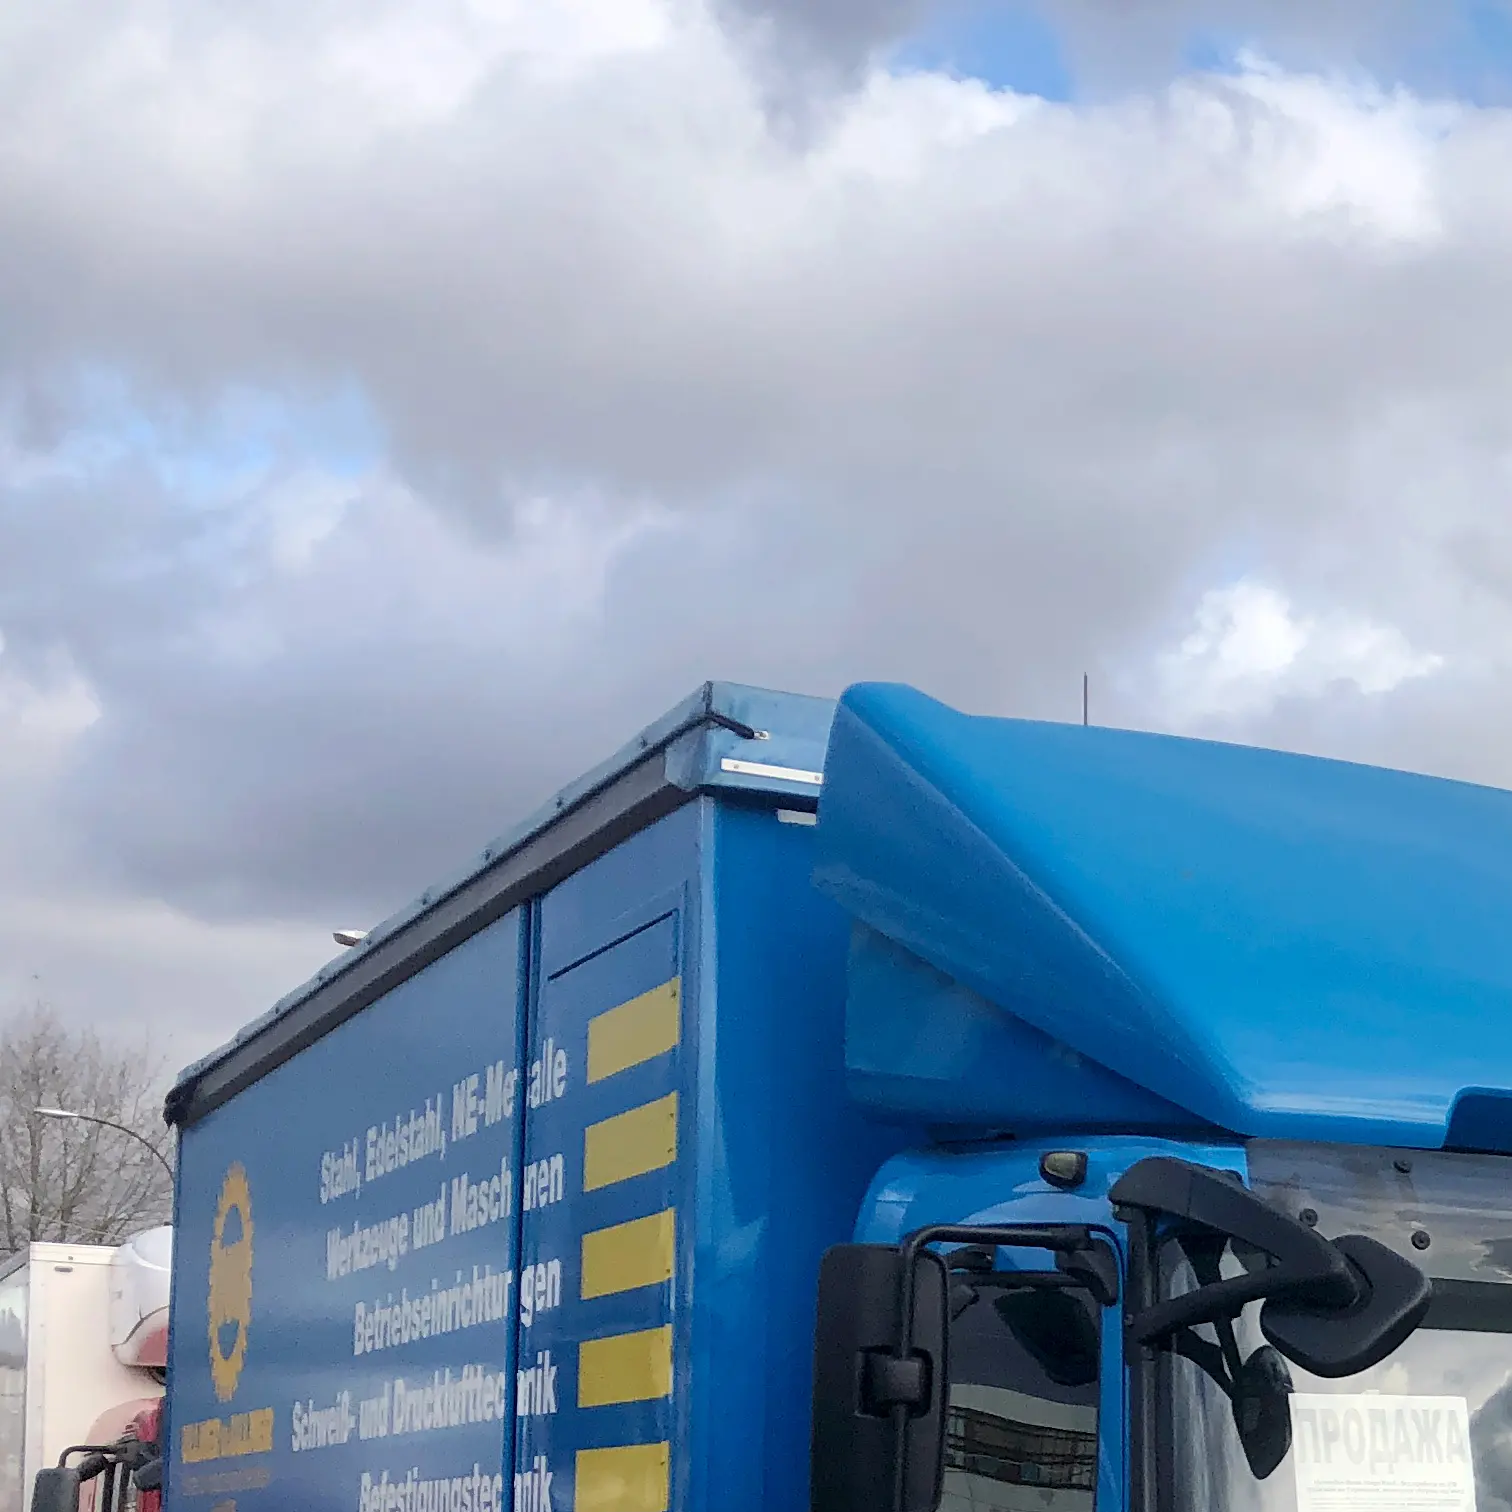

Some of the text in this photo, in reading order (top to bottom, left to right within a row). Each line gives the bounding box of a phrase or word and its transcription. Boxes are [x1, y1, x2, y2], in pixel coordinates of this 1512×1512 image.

[320, 1037, 568, 1204] Stahl, Edelstahl, NE-Mealle
[326, 1153, 564, 1281] Werkzeuge und Maschnen
[359, 1381, 391, 1441] und
[1295, 1407, 1469, 1475] ПРОДАЖА
